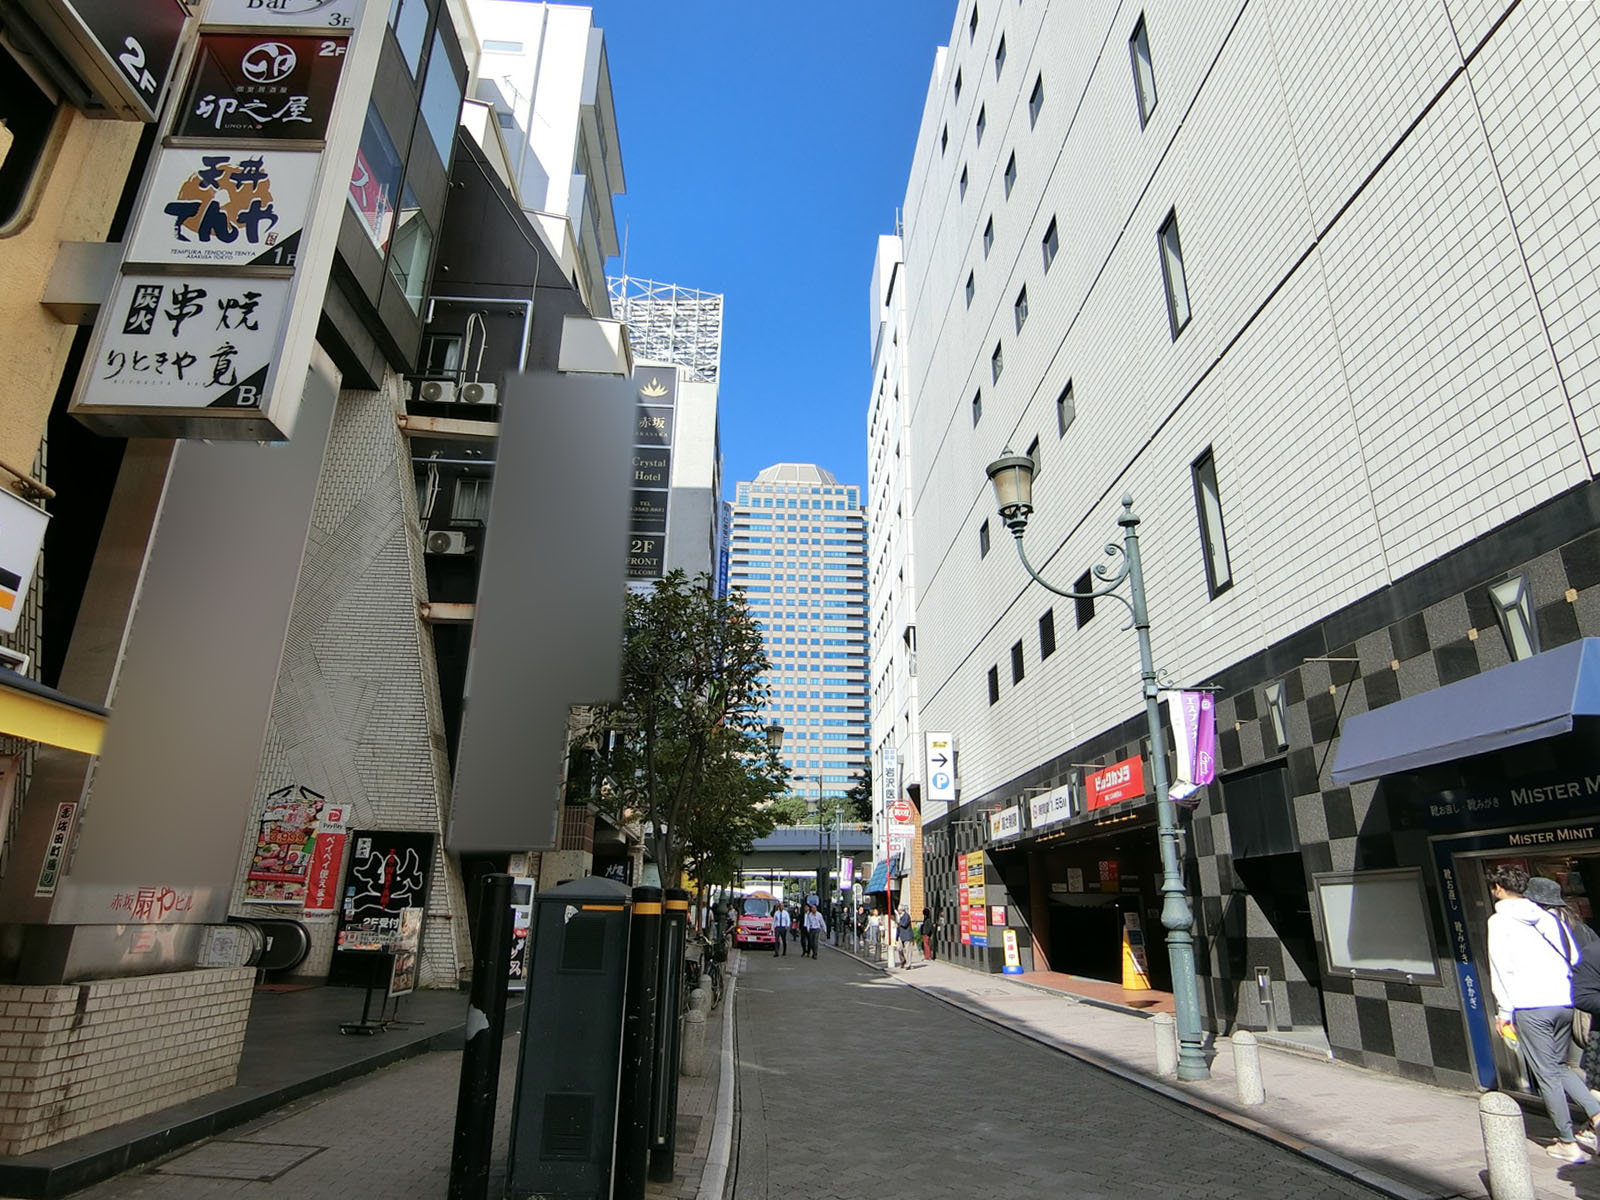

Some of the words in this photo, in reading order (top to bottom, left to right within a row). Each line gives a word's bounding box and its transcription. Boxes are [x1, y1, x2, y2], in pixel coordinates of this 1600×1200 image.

[328, 13, 351, 27] 3F
[319, 41, 347, 57] 2F
[119, 36, 157, 94] 2F
[196, 95, 313, 129] 卯之屋
[198, 155, 268, 192] 天丼
[164, 200, 279, 244] てんや
[274, 246, 296, 265] 1F
[126, 286, 160, 332] 炭火
[164, 284, 262, 338] 串焼
[236, 386, 263, 406] B1
[639, 416, 666, 429] 赤坂
[632, 457, 667, 468] Crystal
[635, 471, 661, 481] Hotel
[631, 540, 655, 553] 2F
[1095, 765, 1130, 791] ビックカメラ
[1511, 782, 1581, 806] MISTER
[322, 822, 344, 830] PayPay
[1509, 832, 1554, 846] MISTER
[1557, 827, 1594, 841] MINIT
[110, 887, 194, 920] 赤坂扇やビル
